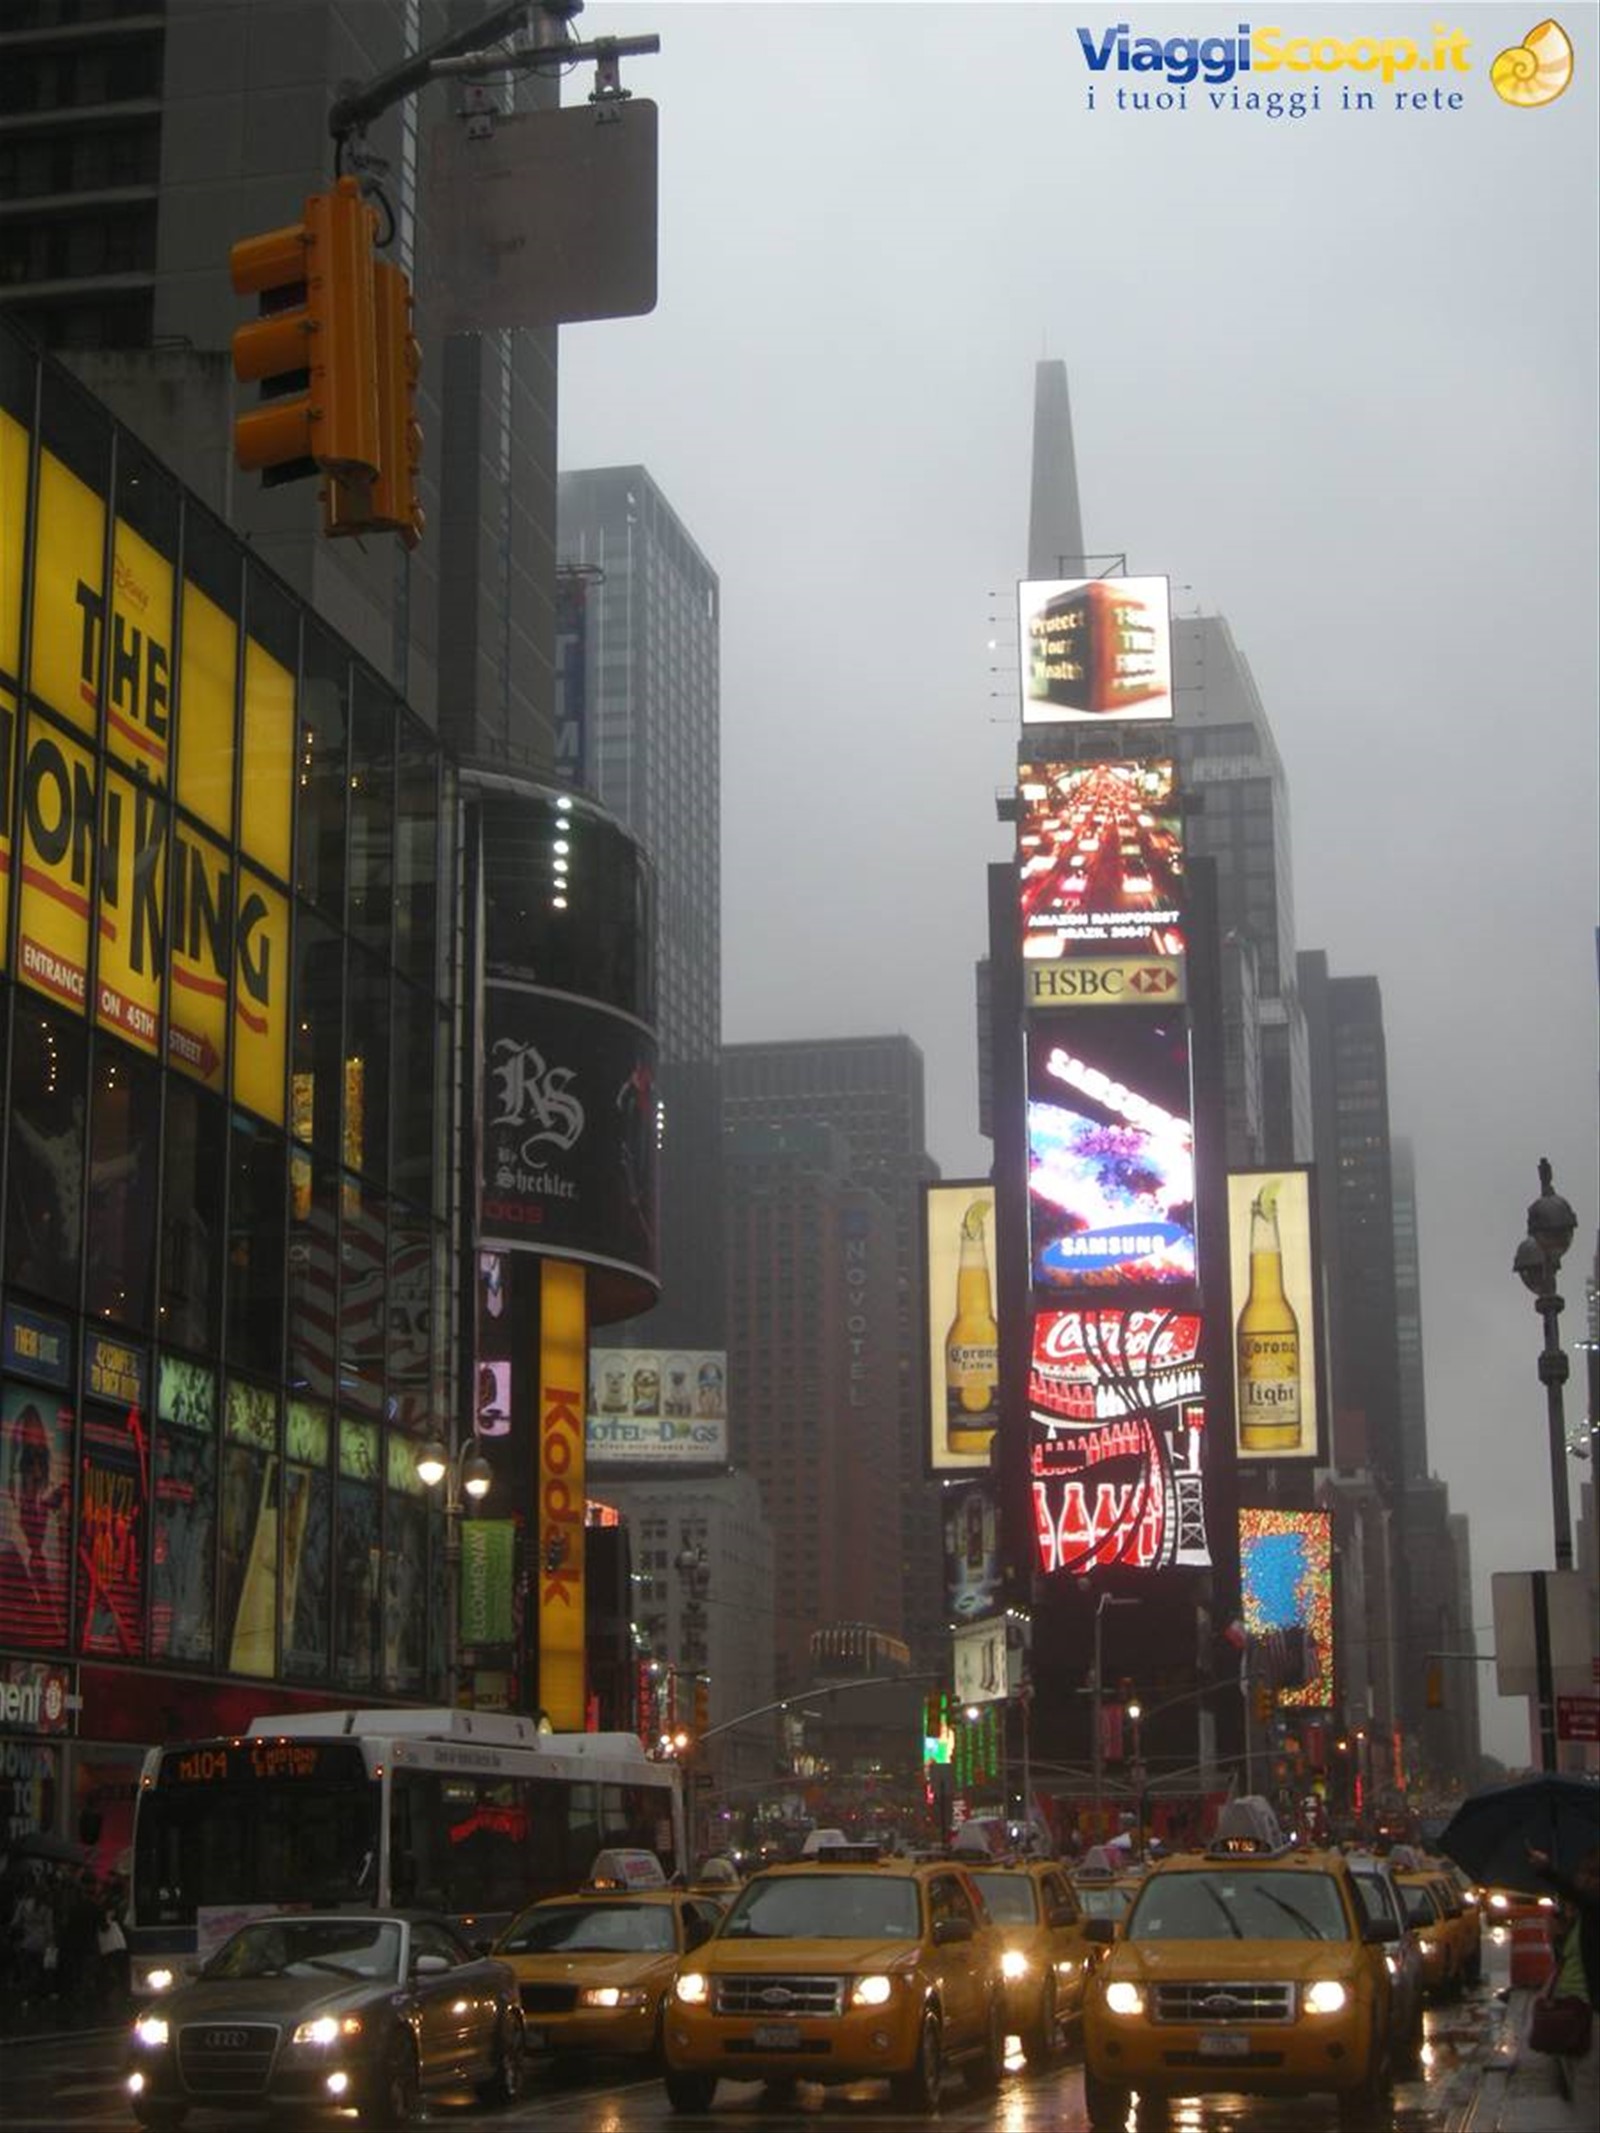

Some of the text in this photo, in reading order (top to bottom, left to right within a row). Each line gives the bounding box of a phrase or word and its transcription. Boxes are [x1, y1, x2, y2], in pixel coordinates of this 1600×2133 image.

[76, 577, 168, 740] THE
[129, 758, 271, 1008] KING
[23, 944, 203, 1065] ENTRANCE ON 45TH STREET
[1032, 968, 1125, 997] HSBC
[1060, 1234, 1166, 1256] SAMSUNG
[541, 1387, 581, 1607] Kodak
